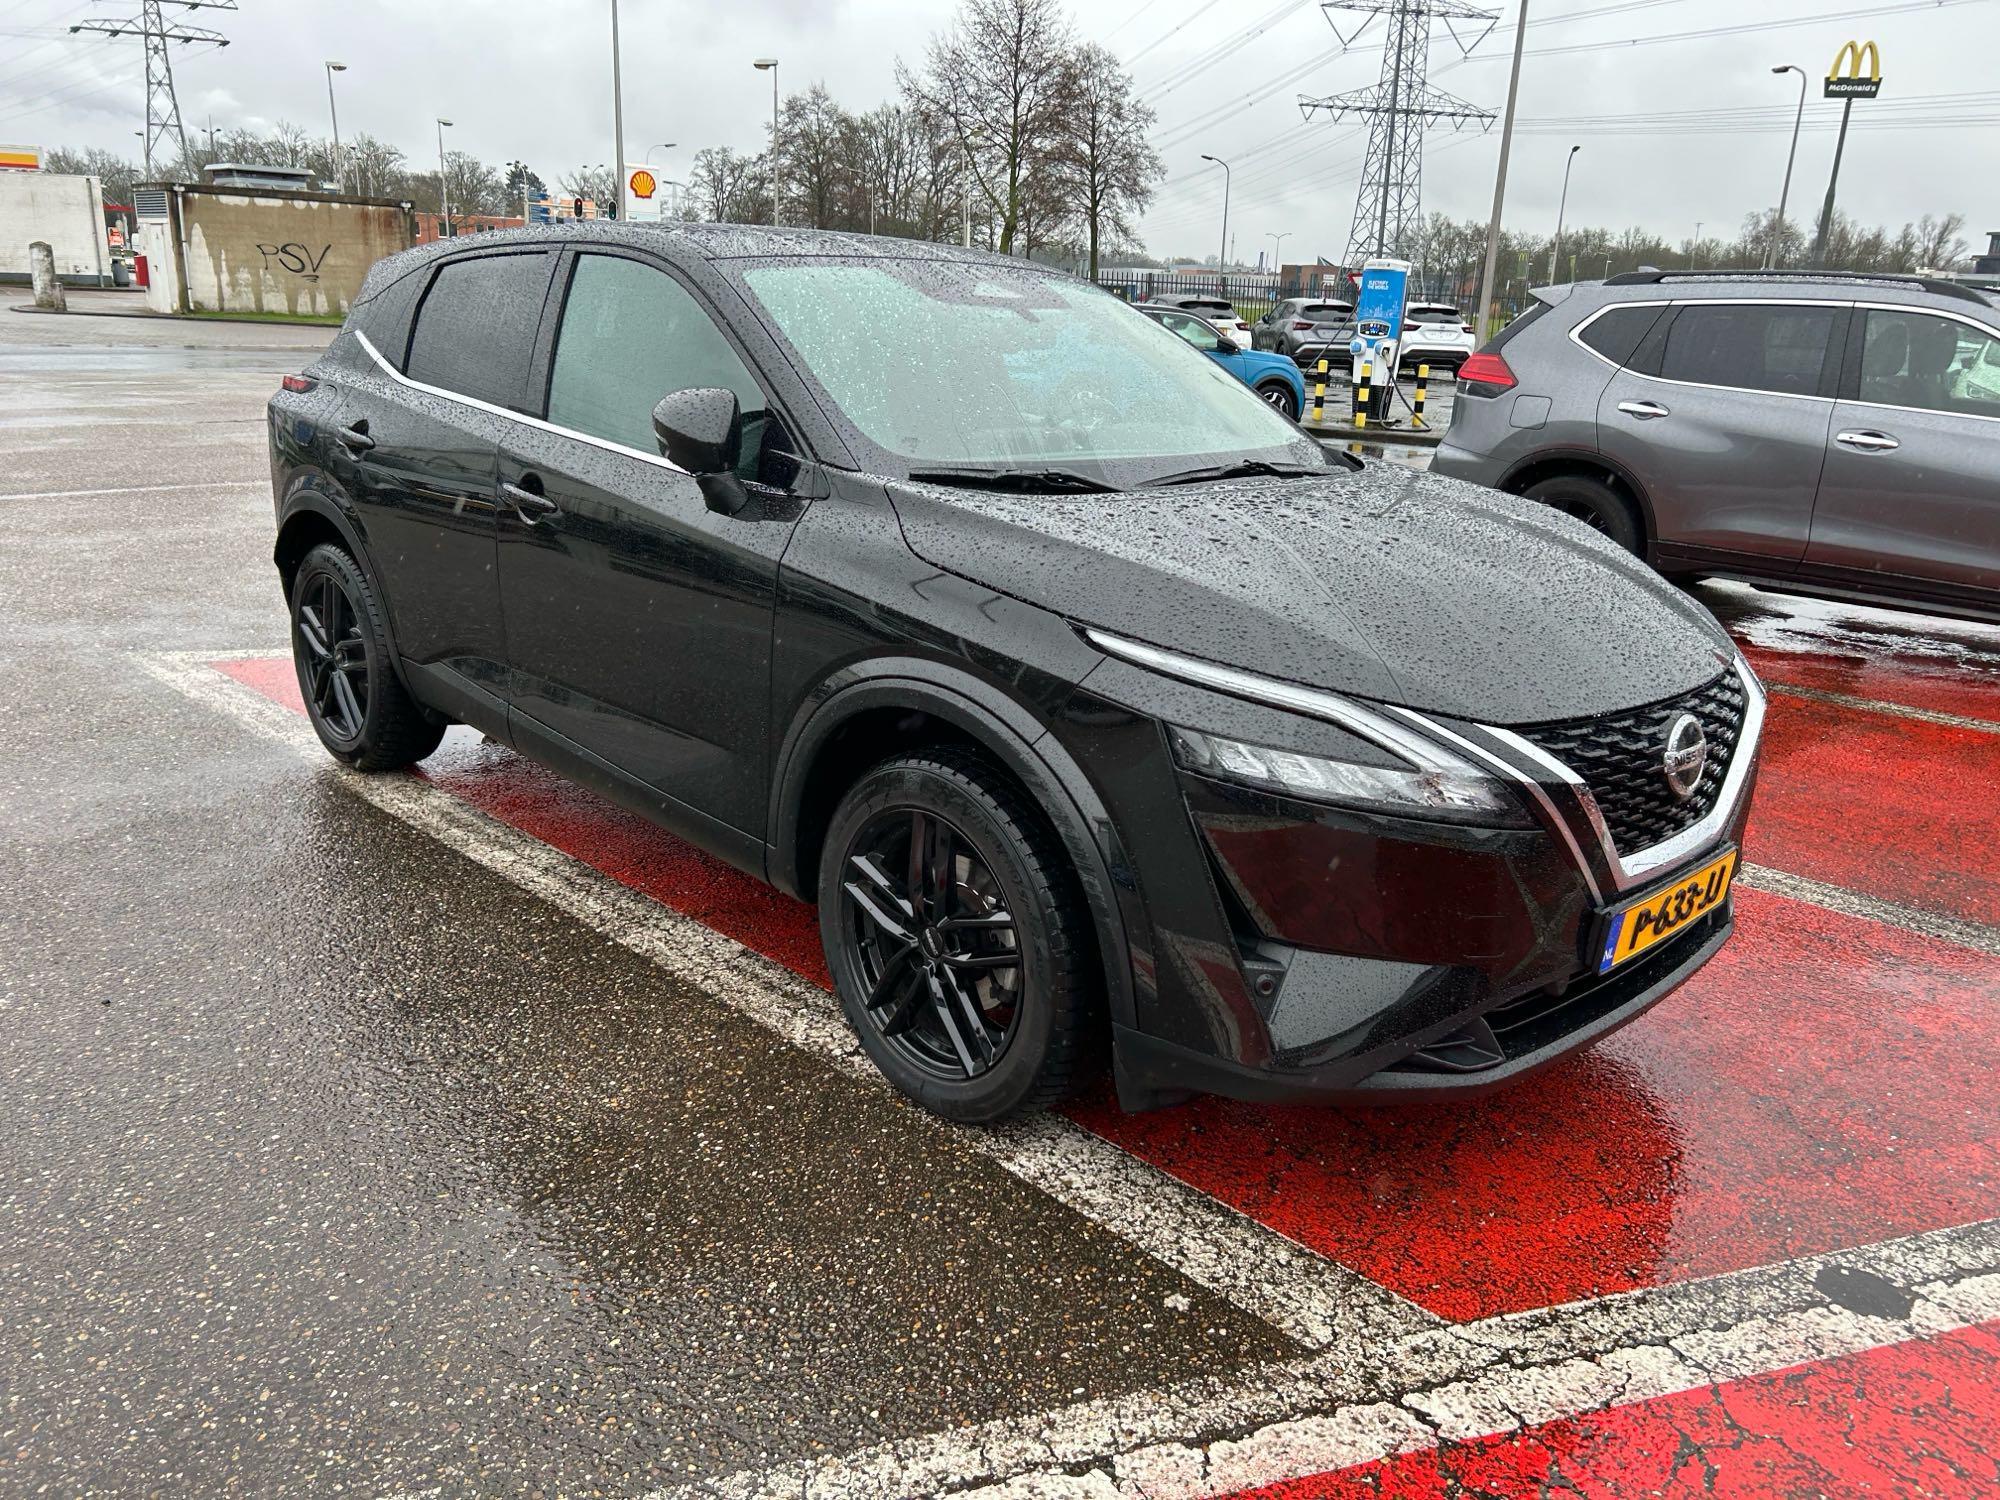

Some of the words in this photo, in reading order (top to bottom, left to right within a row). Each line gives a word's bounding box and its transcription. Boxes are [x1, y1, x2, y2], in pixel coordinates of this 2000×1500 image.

[1828, 84, 1877, 92] McDonald's
[256, 243, 332, 273] PSV
[1602, 948, 1613, 962] NL
